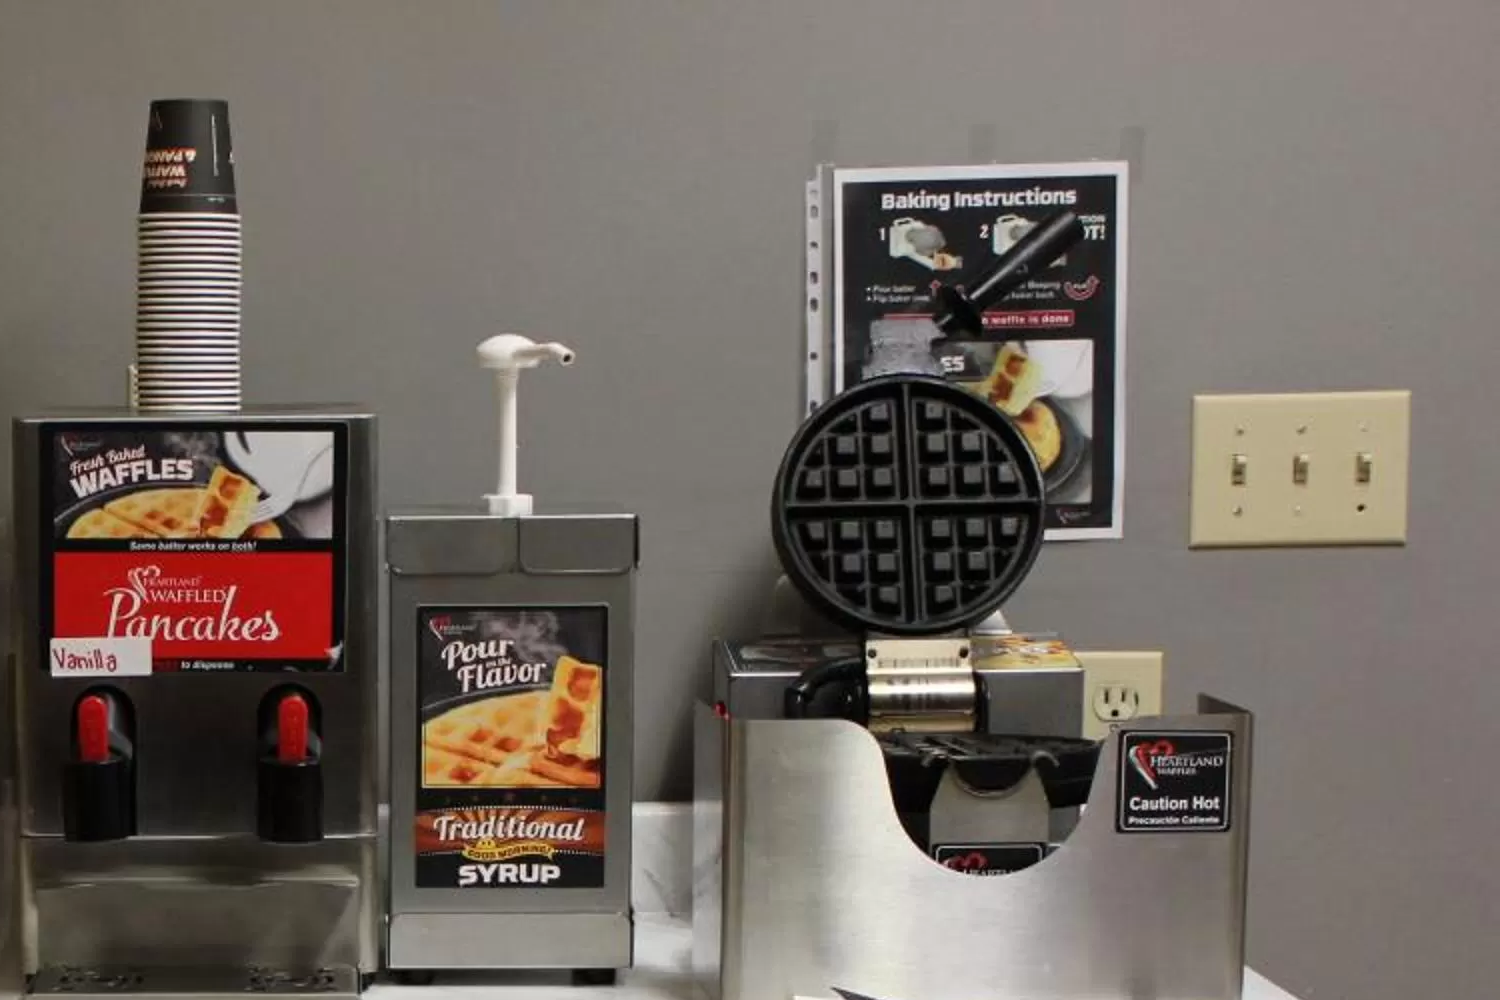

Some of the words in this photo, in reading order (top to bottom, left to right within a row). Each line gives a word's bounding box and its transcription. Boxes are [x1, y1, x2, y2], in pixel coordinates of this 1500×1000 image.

[881, 189, 950, 211] Baking
[954, 186, 1077, 208] Instructions
[878, 227, 886, 241] 1
[979, 224, 989, 239] 2
[1041, 313, 1069, 325] done
[69, 454, 105, 477] Fresh
[106, 444, 146, 464] Baked
[69, 459, 194, 499] WAFFLES
[158, 541, 186, 551] batter
[188, 541, 215, 551] works
[218, 542, 230, 551] on
[149, 589, 227, 603] WAFFLED
[103, 585, 281, 642] Pancakes
[53, 648, 117, 672] Vanilla
[441, 640, 514, 670] Pour
[457, 663, 547, 693] Flavor
[1150, 755, 1224, 767] HEARTLAND
[1129, 795, 1189, 811] Caution
[1192, 795, 1221, 810] Hot
[433, 815, 585, 841] Traditional
[458, 863, 561, 887] SYRUP
